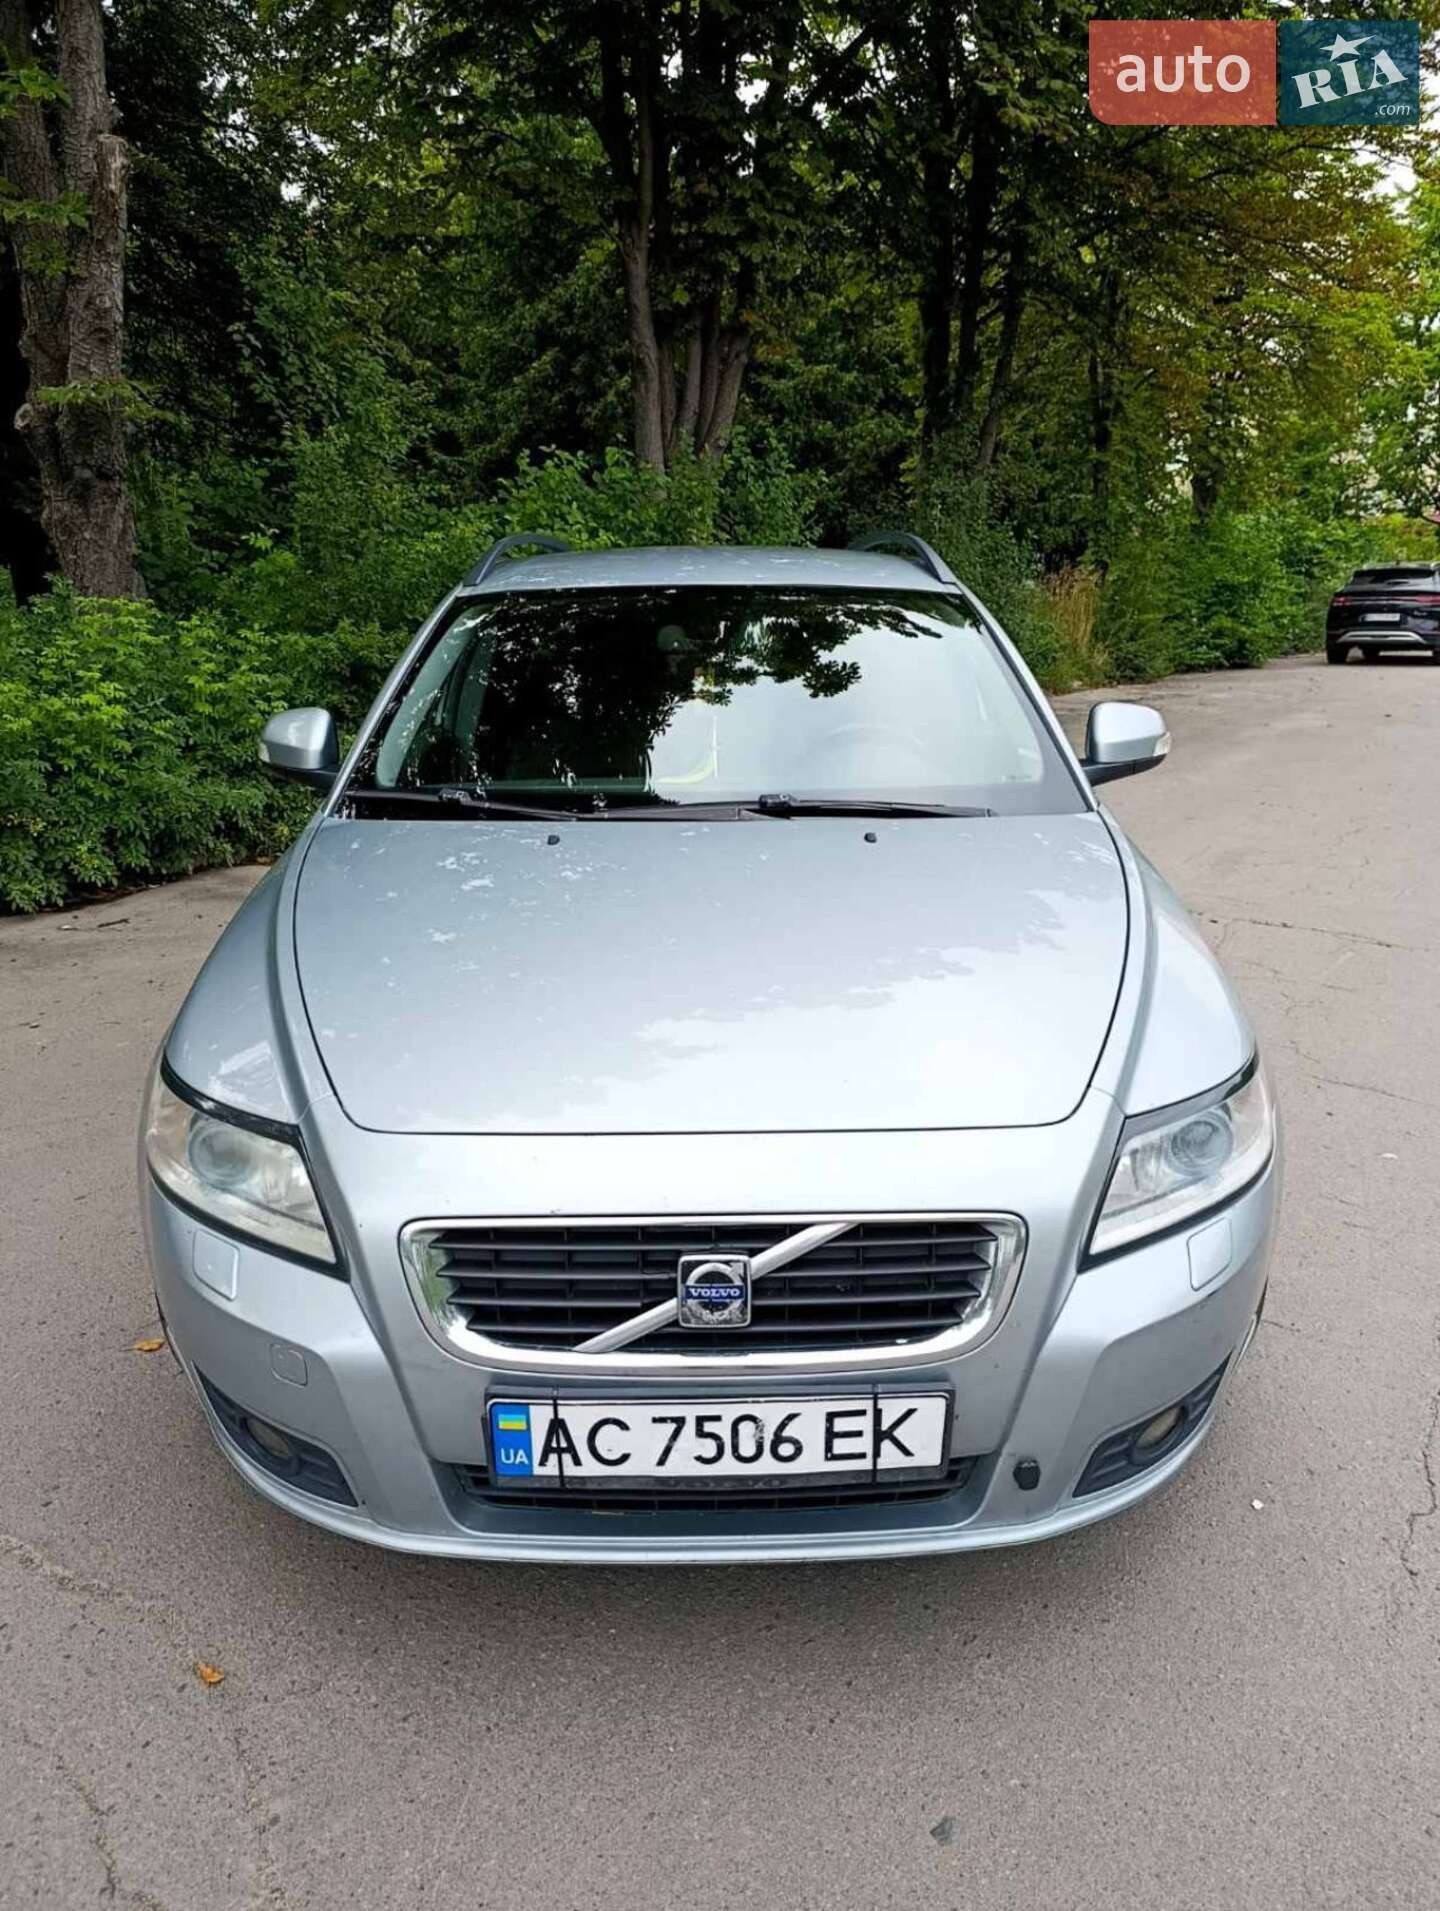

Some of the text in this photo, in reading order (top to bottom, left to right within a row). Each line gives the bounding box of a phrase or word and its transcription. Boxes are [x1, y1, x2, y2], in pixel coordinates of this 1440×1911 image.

[689, 1288, 740, 1297] VOLVO
[538, 1407, 918, 1467] AC 7506 EK
[501, 1448, 529, 1465] UA
